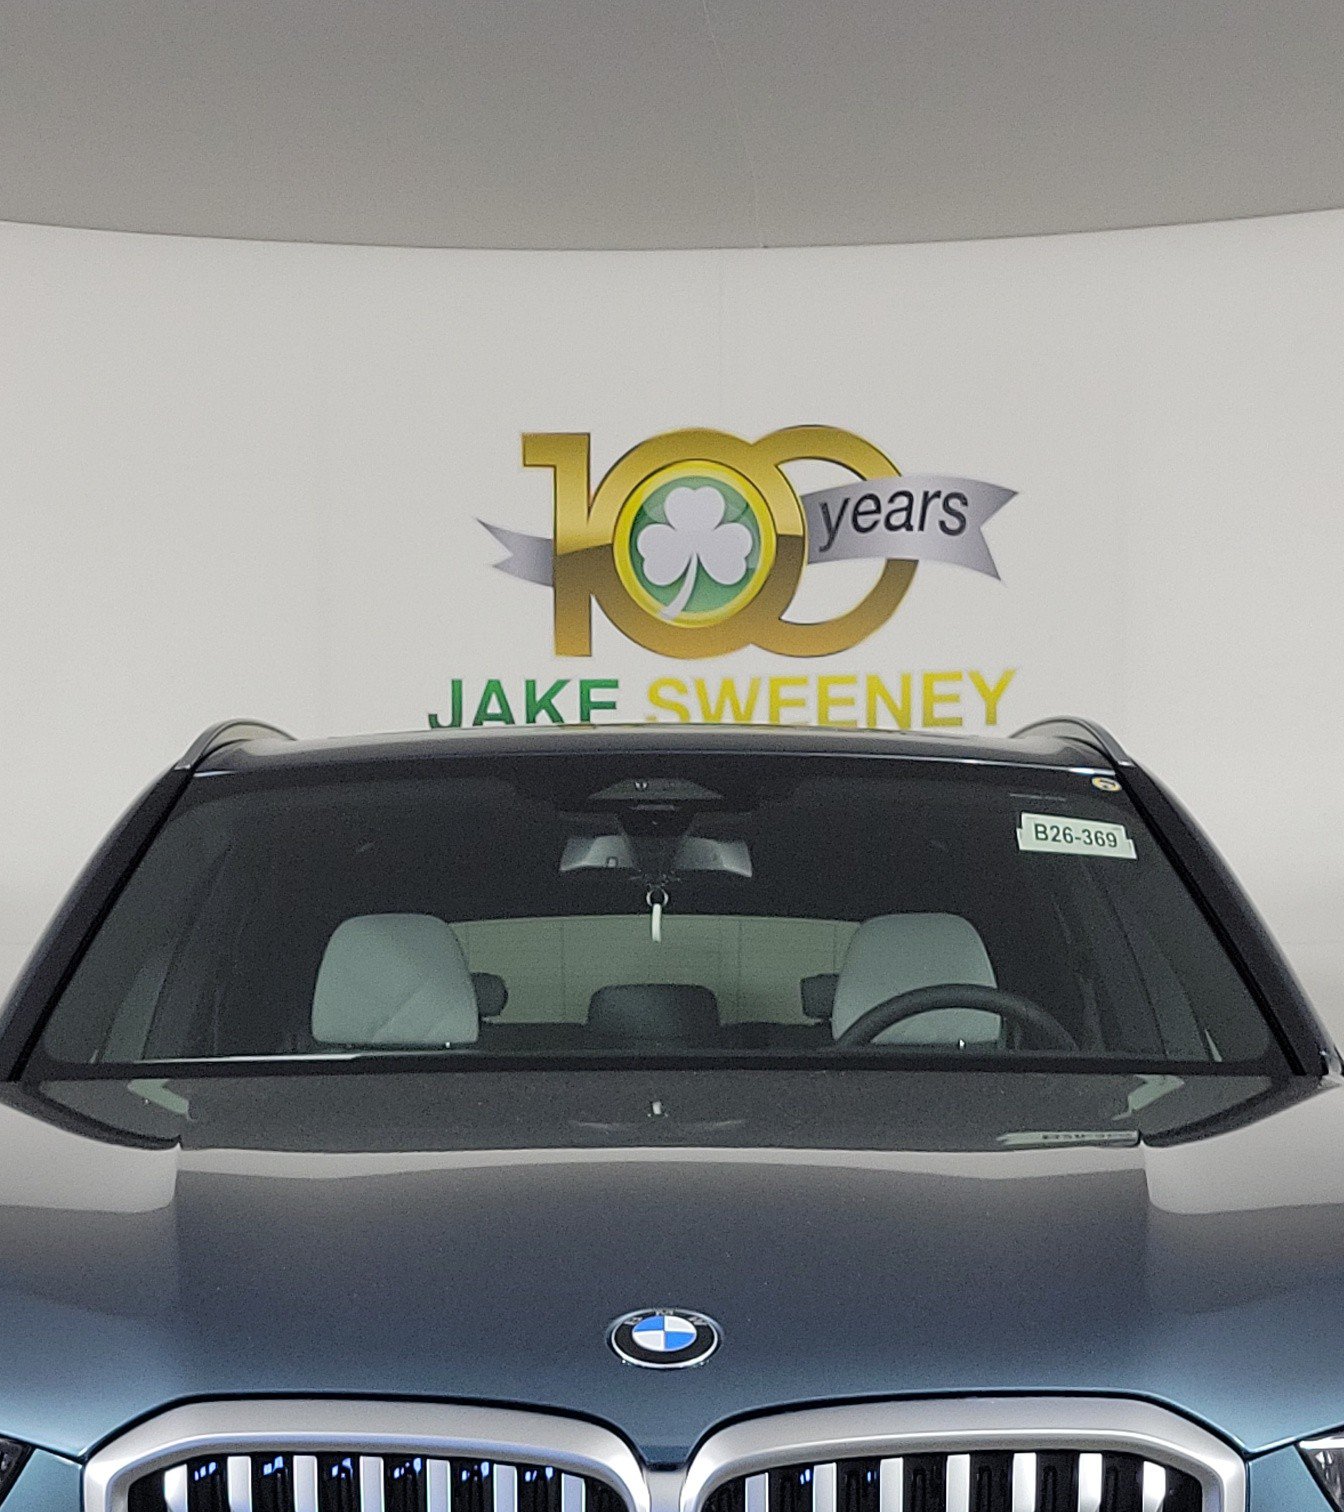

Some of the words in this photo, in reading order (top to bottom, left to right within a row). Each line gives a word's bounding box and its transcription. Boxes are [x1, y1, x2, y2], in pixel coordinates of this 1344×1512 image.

[521, 424, 918, 660] 100
[818, 488, 969, 553] years
[645, 668, 1016, 730] SWEENEY
[1033, 823, 1118, 848] B26-369
